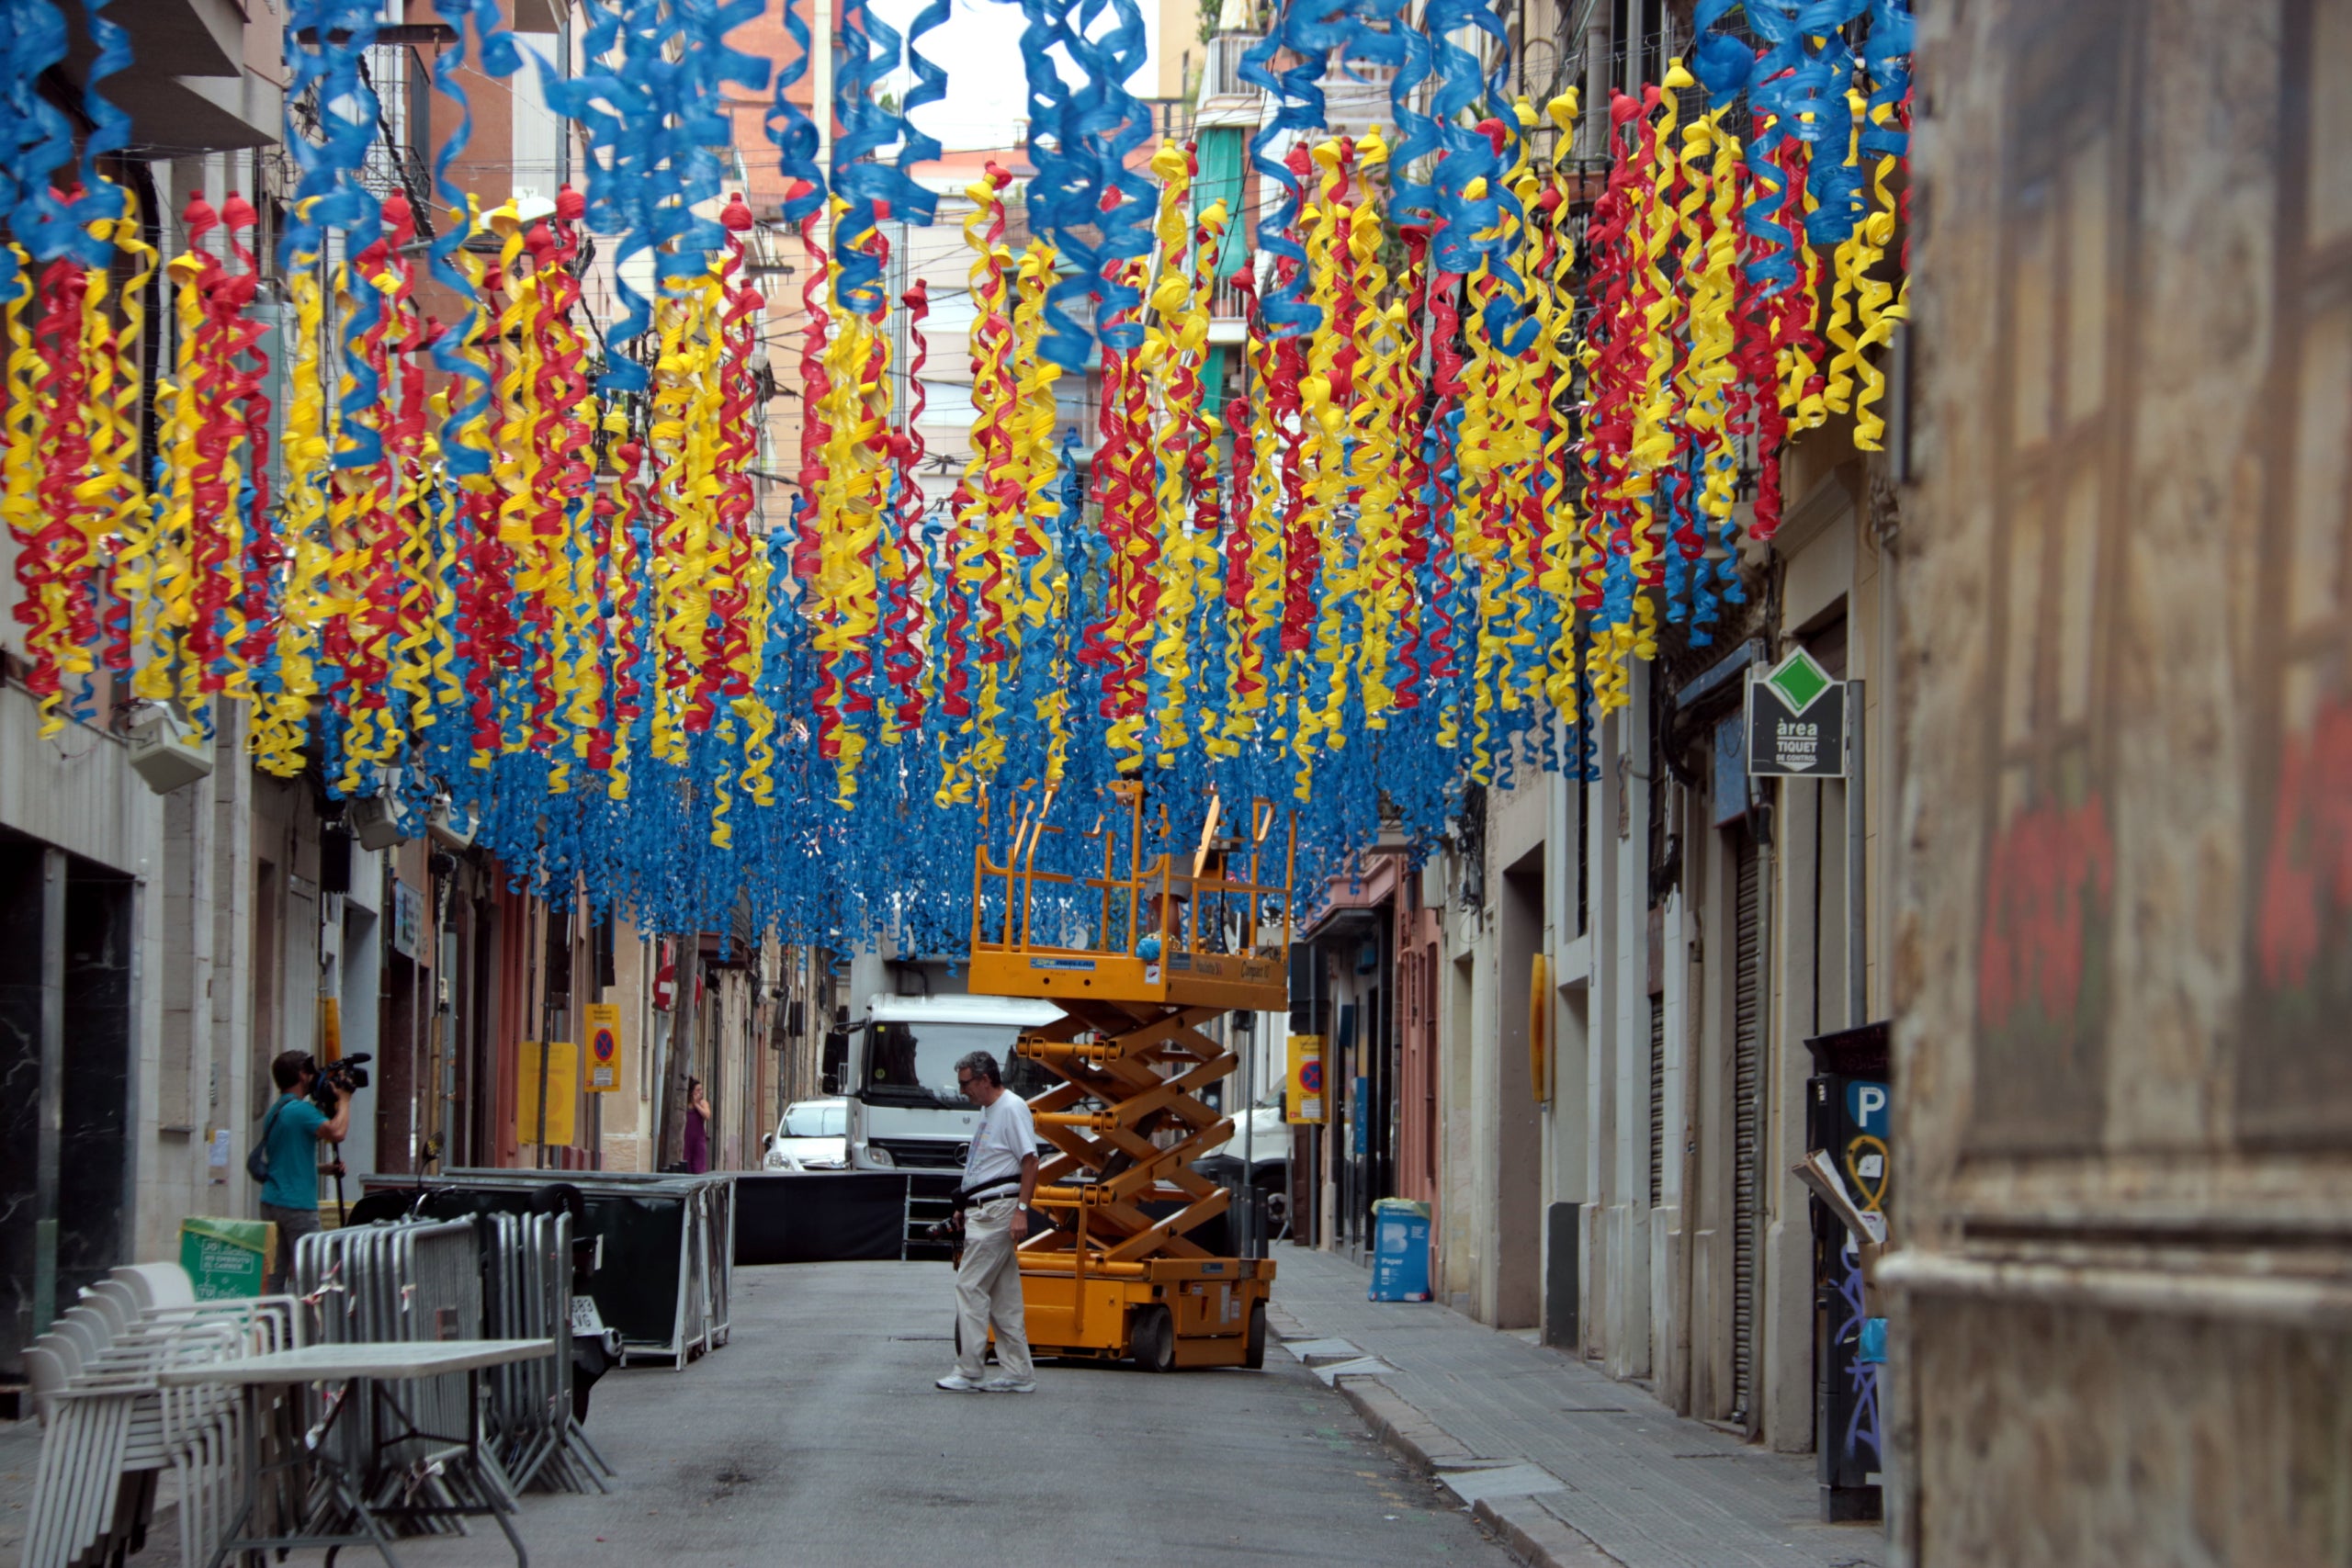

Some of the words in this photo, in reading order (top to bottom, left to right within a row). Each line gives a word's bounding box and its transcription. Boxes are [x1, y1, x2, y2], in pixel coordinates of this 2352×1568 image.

[1777, 717, 1817, 736] àrea
[1777, 741, 1817, 753] TIQUET
[1786, 754, 1817, 762] CONTROL
[1859, 1087, 1885, 1127] P
[204, 1242, 217, 1251] JO
[1381, 1258, 1403, 1266] Paper
